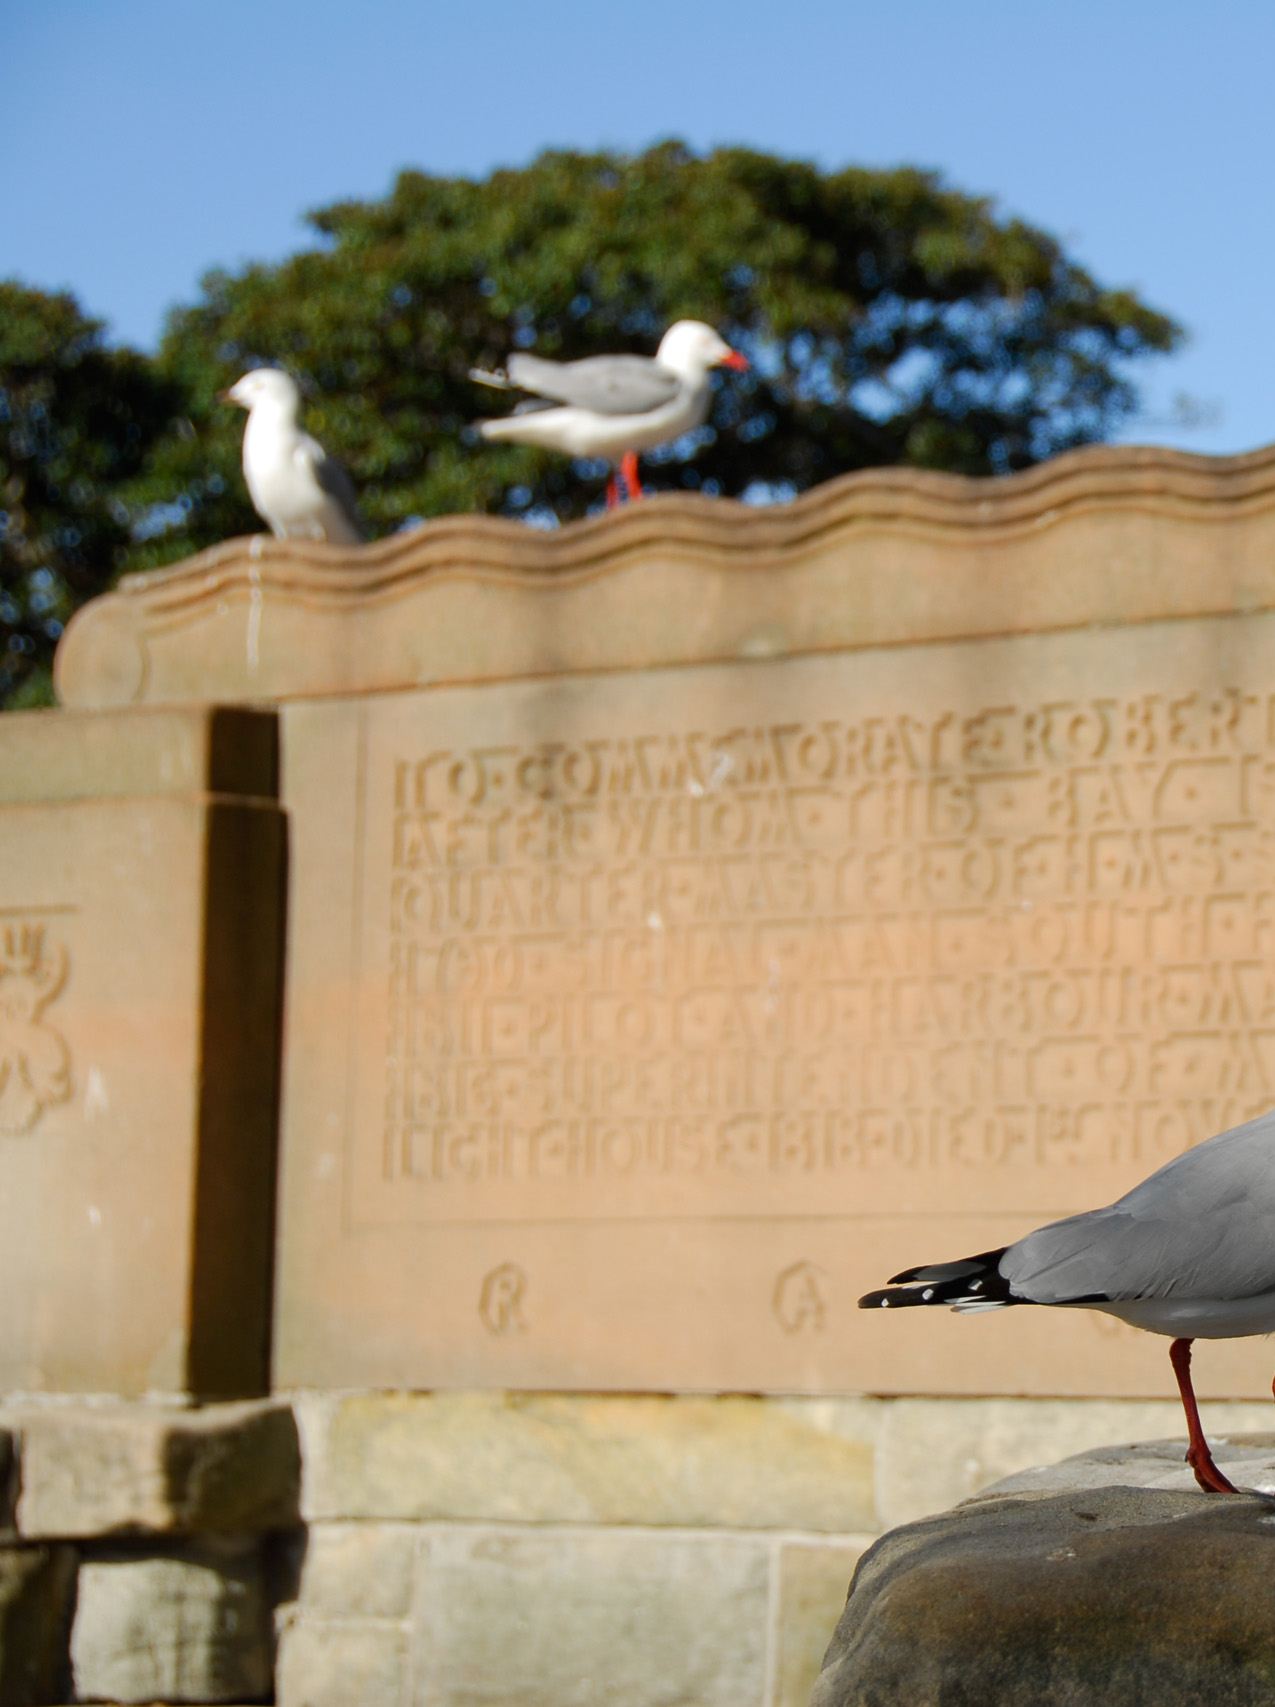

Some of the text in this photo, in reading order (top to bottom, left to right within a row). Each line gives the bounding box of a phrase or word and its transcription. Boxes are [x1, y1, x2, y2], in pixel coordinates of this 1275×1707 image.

[402, 744, 490, 806] TO
[512, 702, 990, 800] COMMEMORATE
[402, 800, 577, 867] AFTER
[603, 784, 800, 855] WHOM
[832, 771, 980, 842] THIS
[1038, 757, 1174, 829] BAY
[402, 856, 671, 933] QUARTER
[953, 833, 1036, 902] OF
[976, 892, 1210, 968] SOUTH
[521, 986, 692, 1053] PILOT
[862, 962, 1175, 1039] HARBOUR
[1086, 1027, 1168, 1095] OF
[397, 1111, 744, 1182] LIGHTHOUSE
